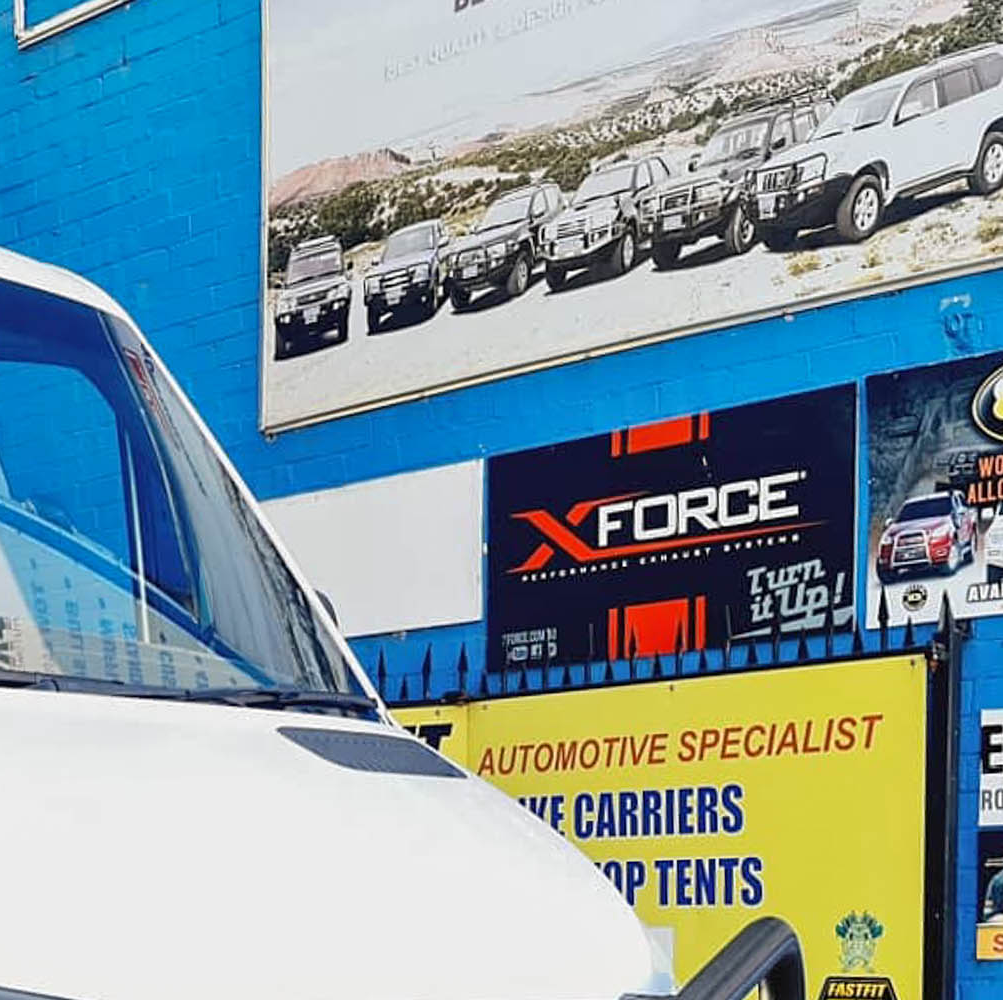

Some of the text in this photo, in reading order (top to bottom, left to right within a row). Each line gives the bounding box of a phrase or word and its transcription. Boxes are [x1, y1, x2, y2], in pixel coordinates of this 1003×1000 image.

[505, 472, 805, 574] XFORCE
[521, 533, 800, 582] PERFORMANCE EXHAUST SYSTEMS
[747, 559, 826, 595] Turn
[750, 594, 774, 623] it
[477, 714, 885, 777] AUTOMOTIVE SPECIALIST
[573, 784, 745, 839] CARRIERS
[654, 857, 764, 906] TENTS
[827, 982, 887, 998] FASTFIT
